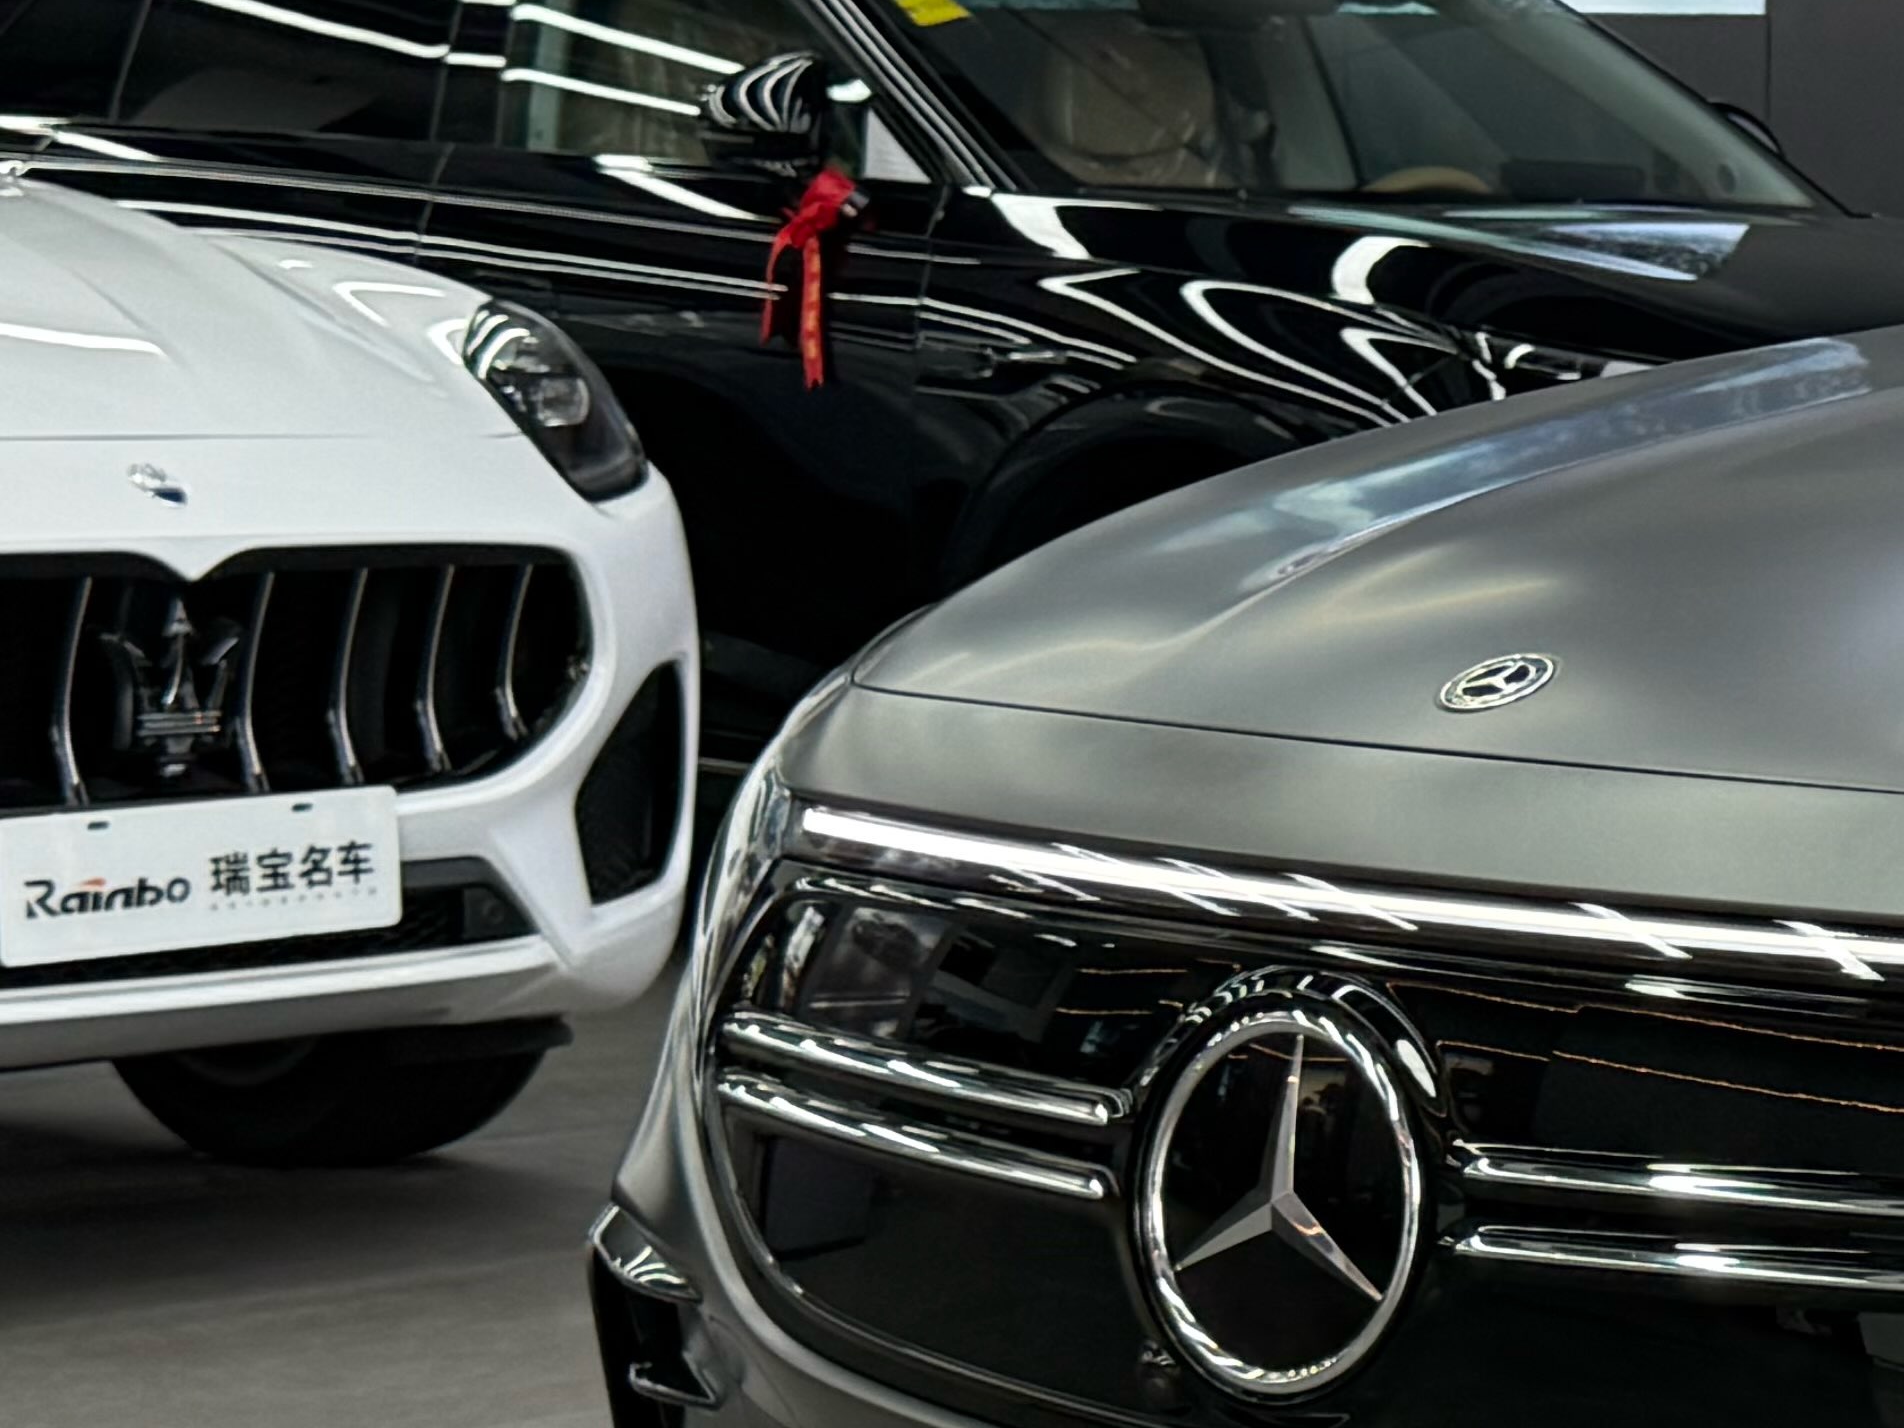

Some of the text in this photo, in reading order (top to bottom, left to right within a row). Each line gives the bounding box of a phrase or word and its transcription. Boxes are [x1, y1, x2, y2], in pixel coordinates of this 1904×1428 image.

[24, 876, 190, 919] Rainbo
[209, 840, 374, 897] 瑞宝名车
